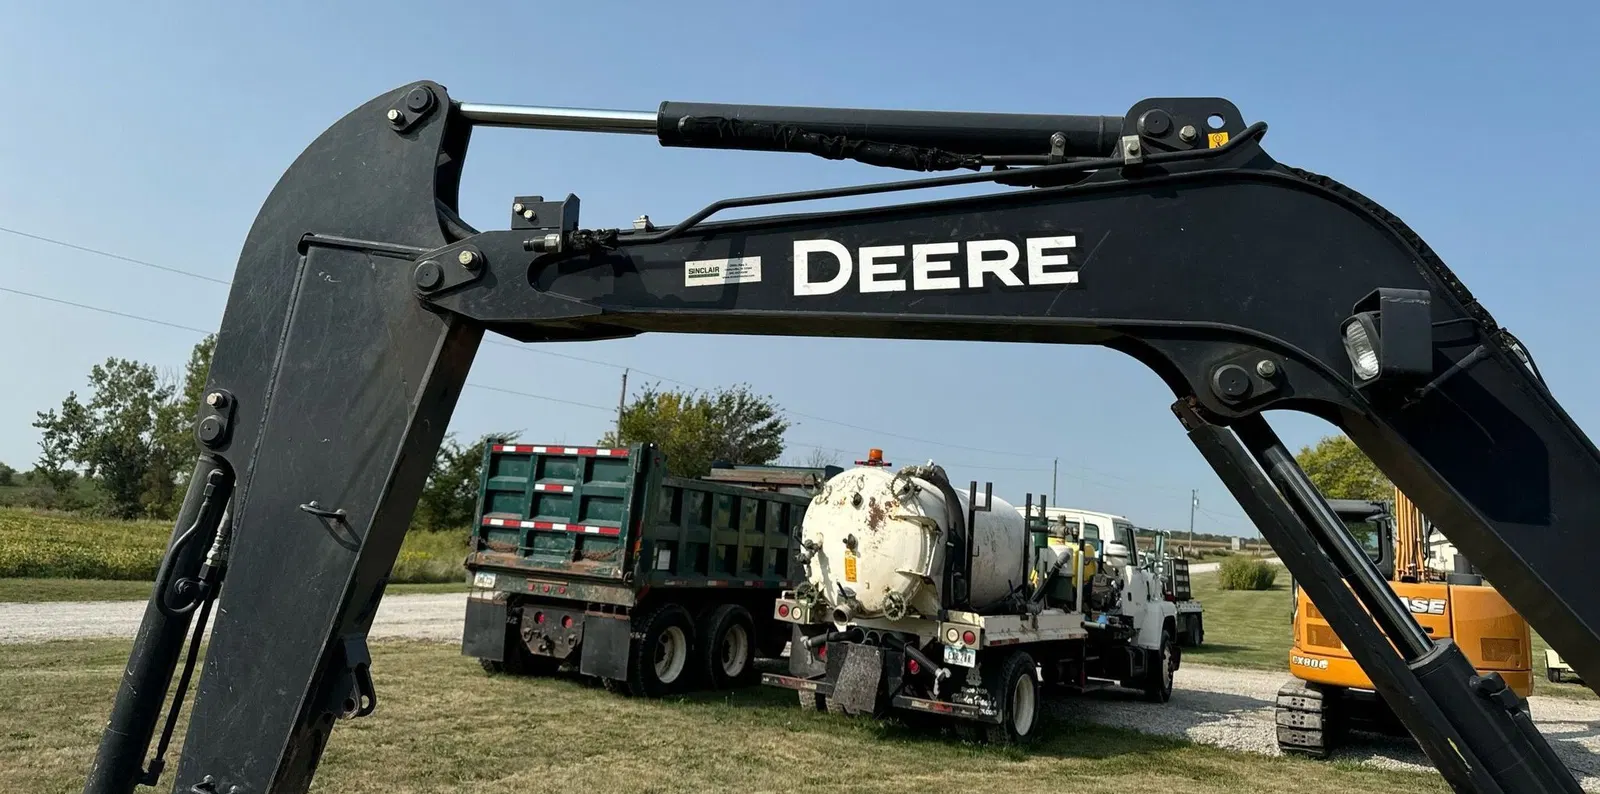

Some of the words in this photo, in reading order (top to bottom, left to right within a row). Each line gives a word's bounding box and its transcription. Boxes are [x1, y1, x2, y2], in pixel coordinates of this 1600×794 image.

[688, 266, 720, 275] SINCLAIR
[793, 235, 1079, 296] DEERE
[1399, 596, 1447, 615] ASE
